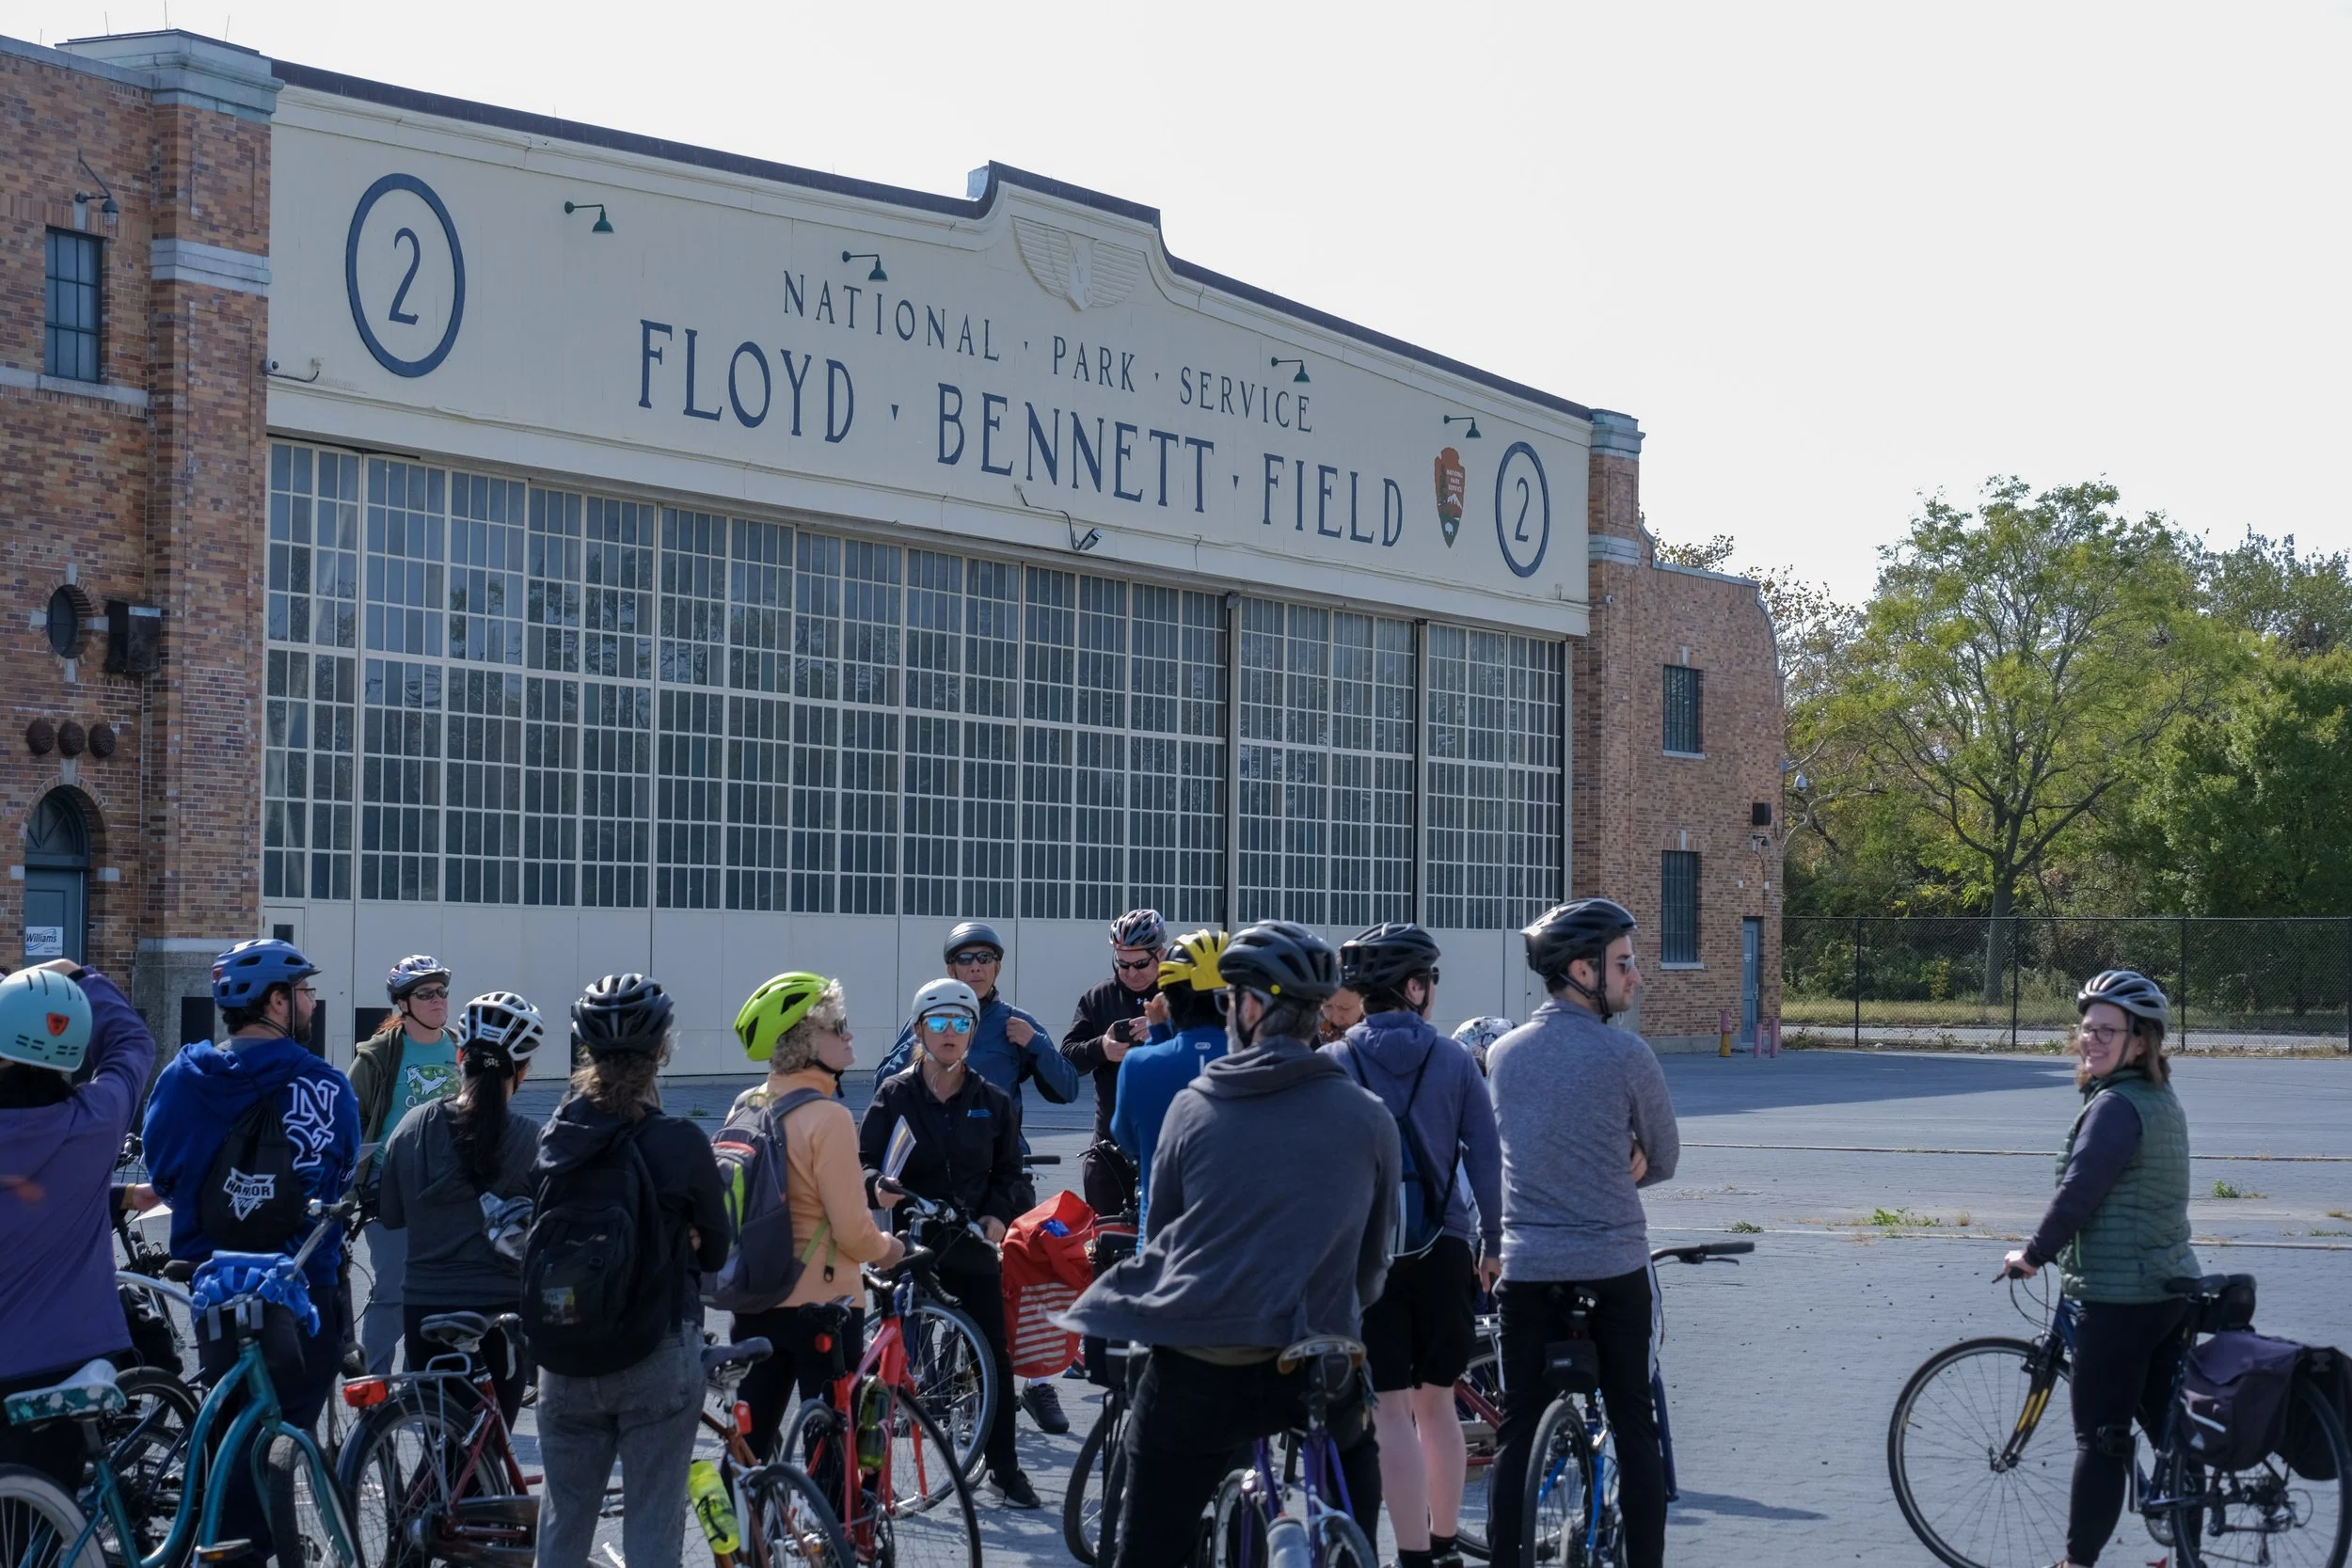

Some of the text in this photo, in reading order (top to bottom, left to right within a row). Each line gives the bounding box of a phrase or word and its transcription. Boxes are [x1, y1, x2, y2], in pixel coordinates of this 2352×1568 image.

[388, 227, 421, 325] 2
[784, 270, 1312, 433] NATIONAL PARK SERVICE
[638, 318, 1404, 547] FLOYD BENNETT FIELD
[1516, 477, 1529, 542] 2
[26, 933, 56, 942] Williams
[225, 1179, 271, 1196] HAROR
